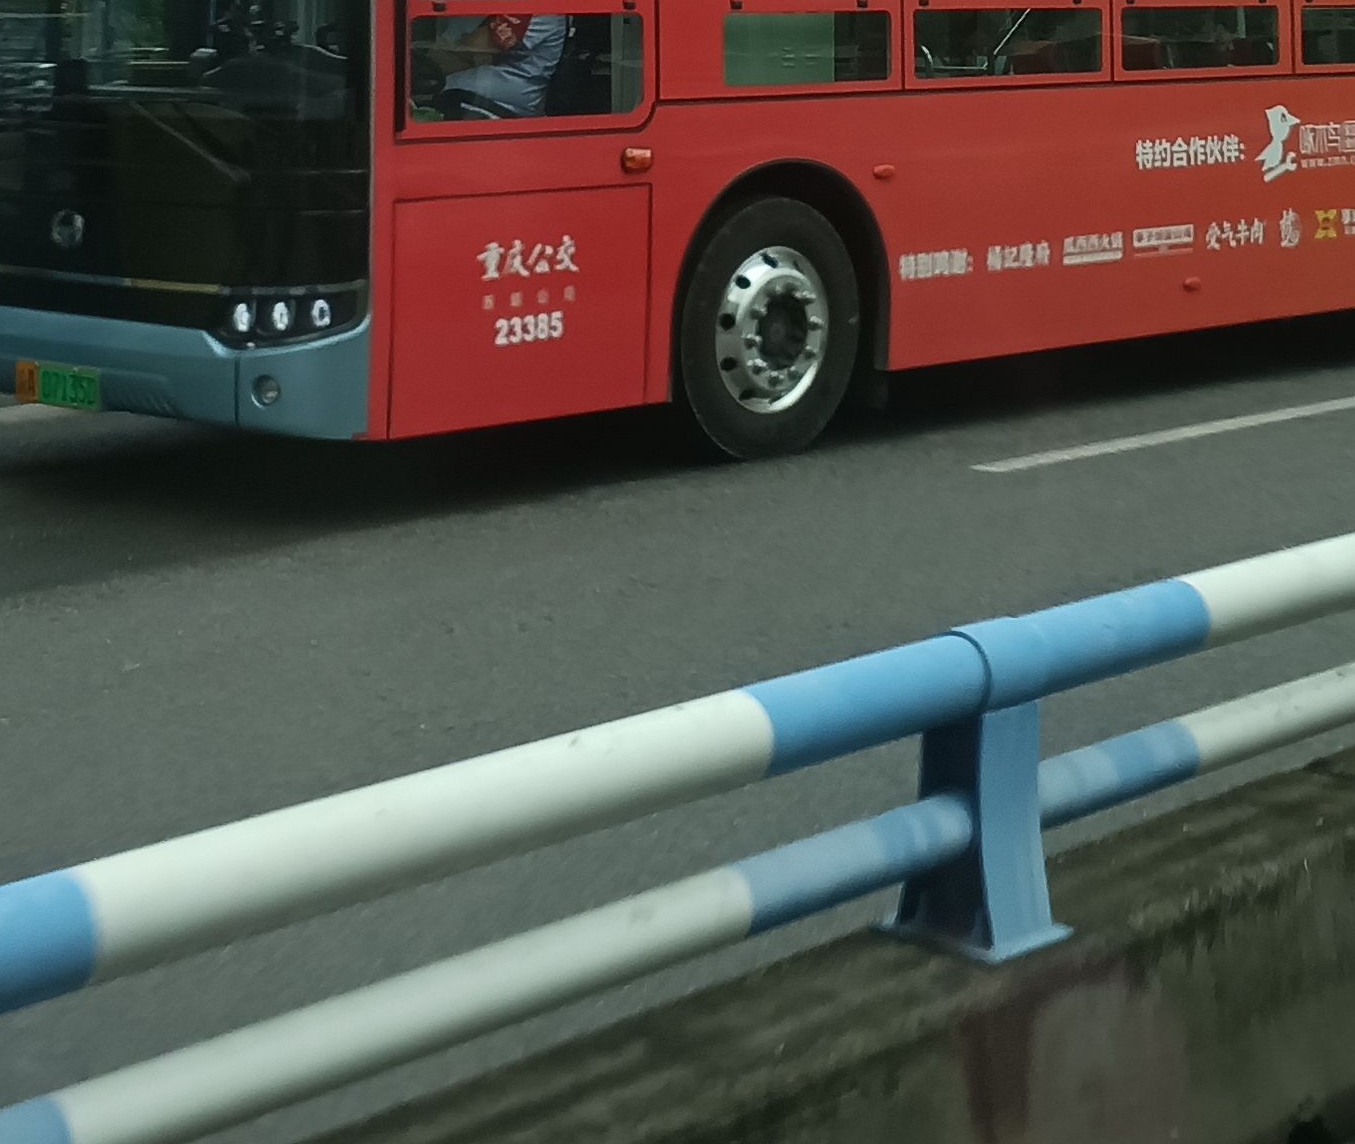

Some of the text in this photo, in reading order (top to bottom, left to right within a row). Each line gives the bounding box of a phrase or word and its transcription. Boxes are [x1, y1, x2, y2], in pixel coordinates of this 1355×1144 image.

[1135, 133, 1246, 170] 特约合作伙伴:
[477, 235, 580, 281] 重庆公交
[495, 311, 564, 346] 23385
